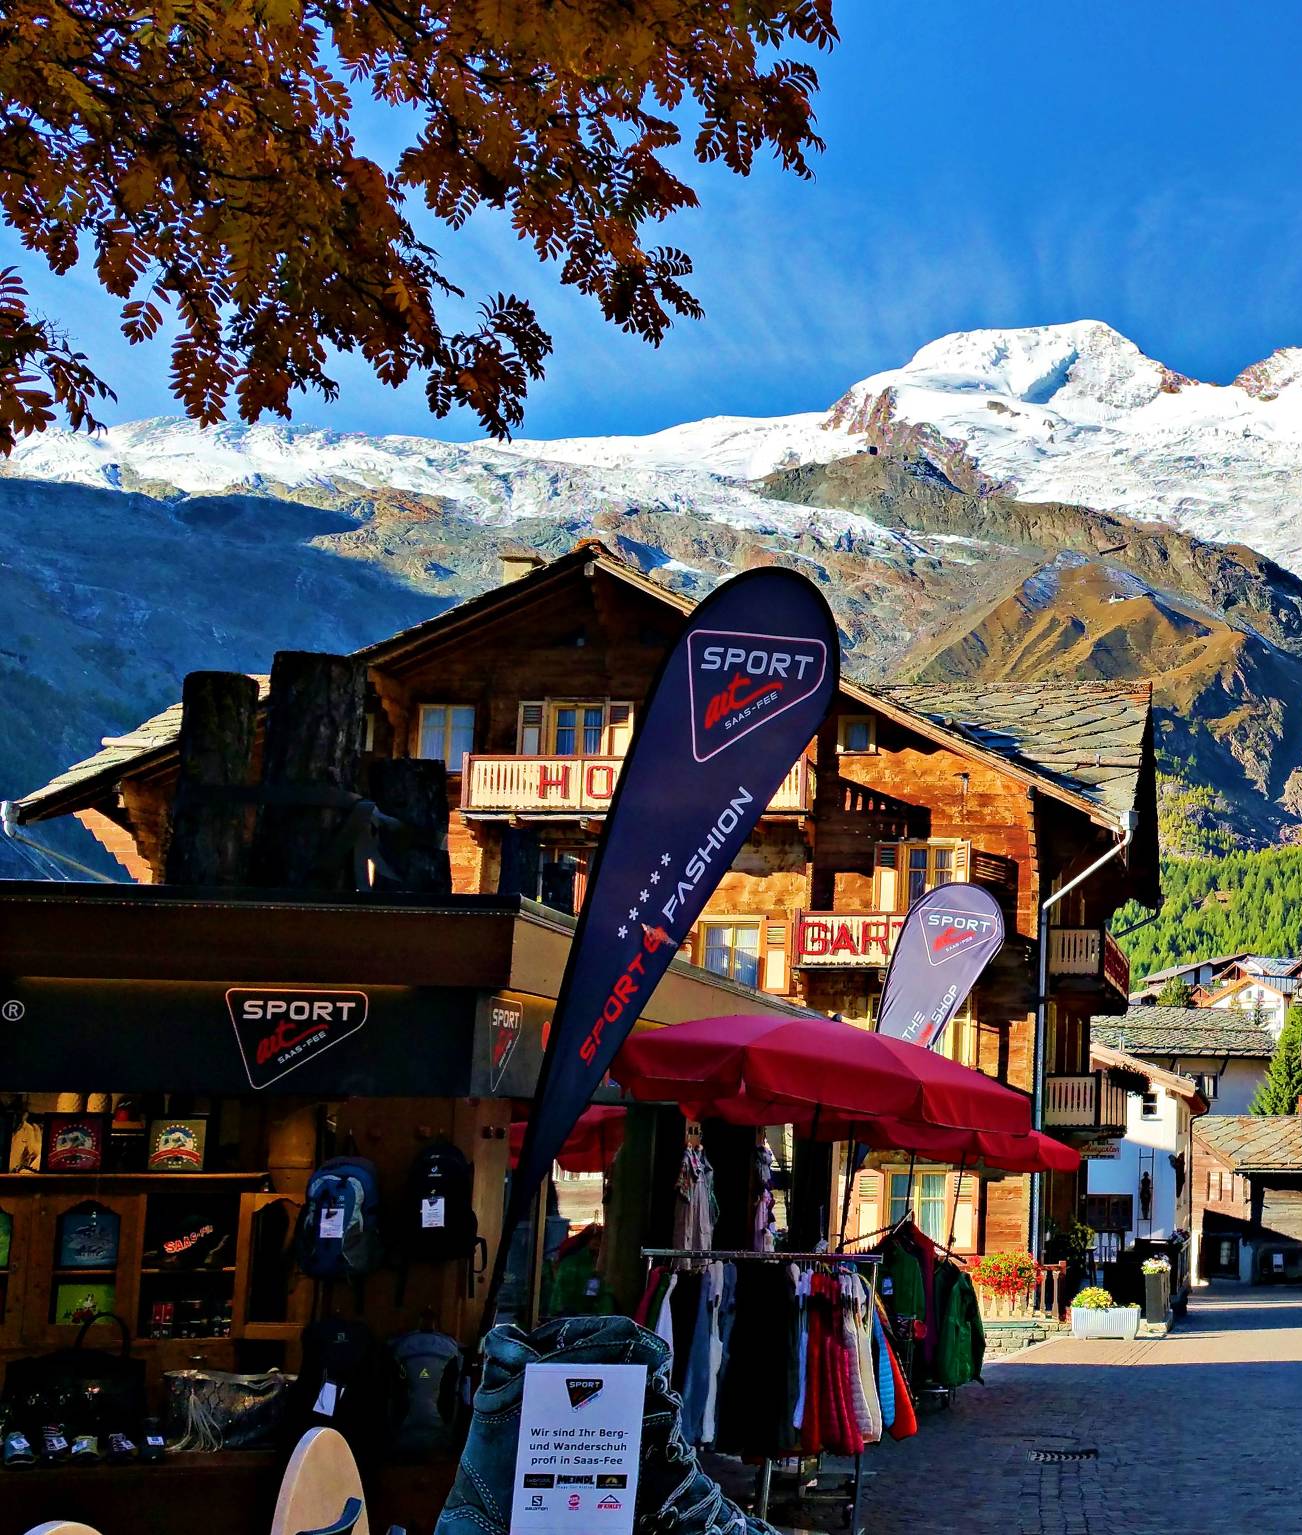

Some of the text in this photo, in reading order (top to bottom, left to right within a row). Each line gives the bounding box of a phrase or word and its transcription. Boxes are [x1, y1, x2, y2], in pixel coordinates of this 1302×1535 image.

[701, 646, 814, 680] SPORT
[724, 691, 778, 730] SAAS-FEE
[538, 764, 617, 800] HO
[579, 953, 646, 1067] SPORT
[662, 786, 754, 923] FASHION
[799, 921, 905, 956] GAR
[927, 914, 992, 933] SPORT
[242, 1000, 356, 1021] SPORT
[492, 1008, 520, 1030] SPORT
[931, 984, 958, 1024] SHOP
[901, 1011, 926, 1040] THE
[277, 1030, 327, 1064] SAAS-FEE
[529, 1442, 627, 1451] und Wanderschuh
[530, 1428, 629, 1439] Wir sind Ihr Berg-
[530, 1456, 623, 1466] profi in Saas-Fee
